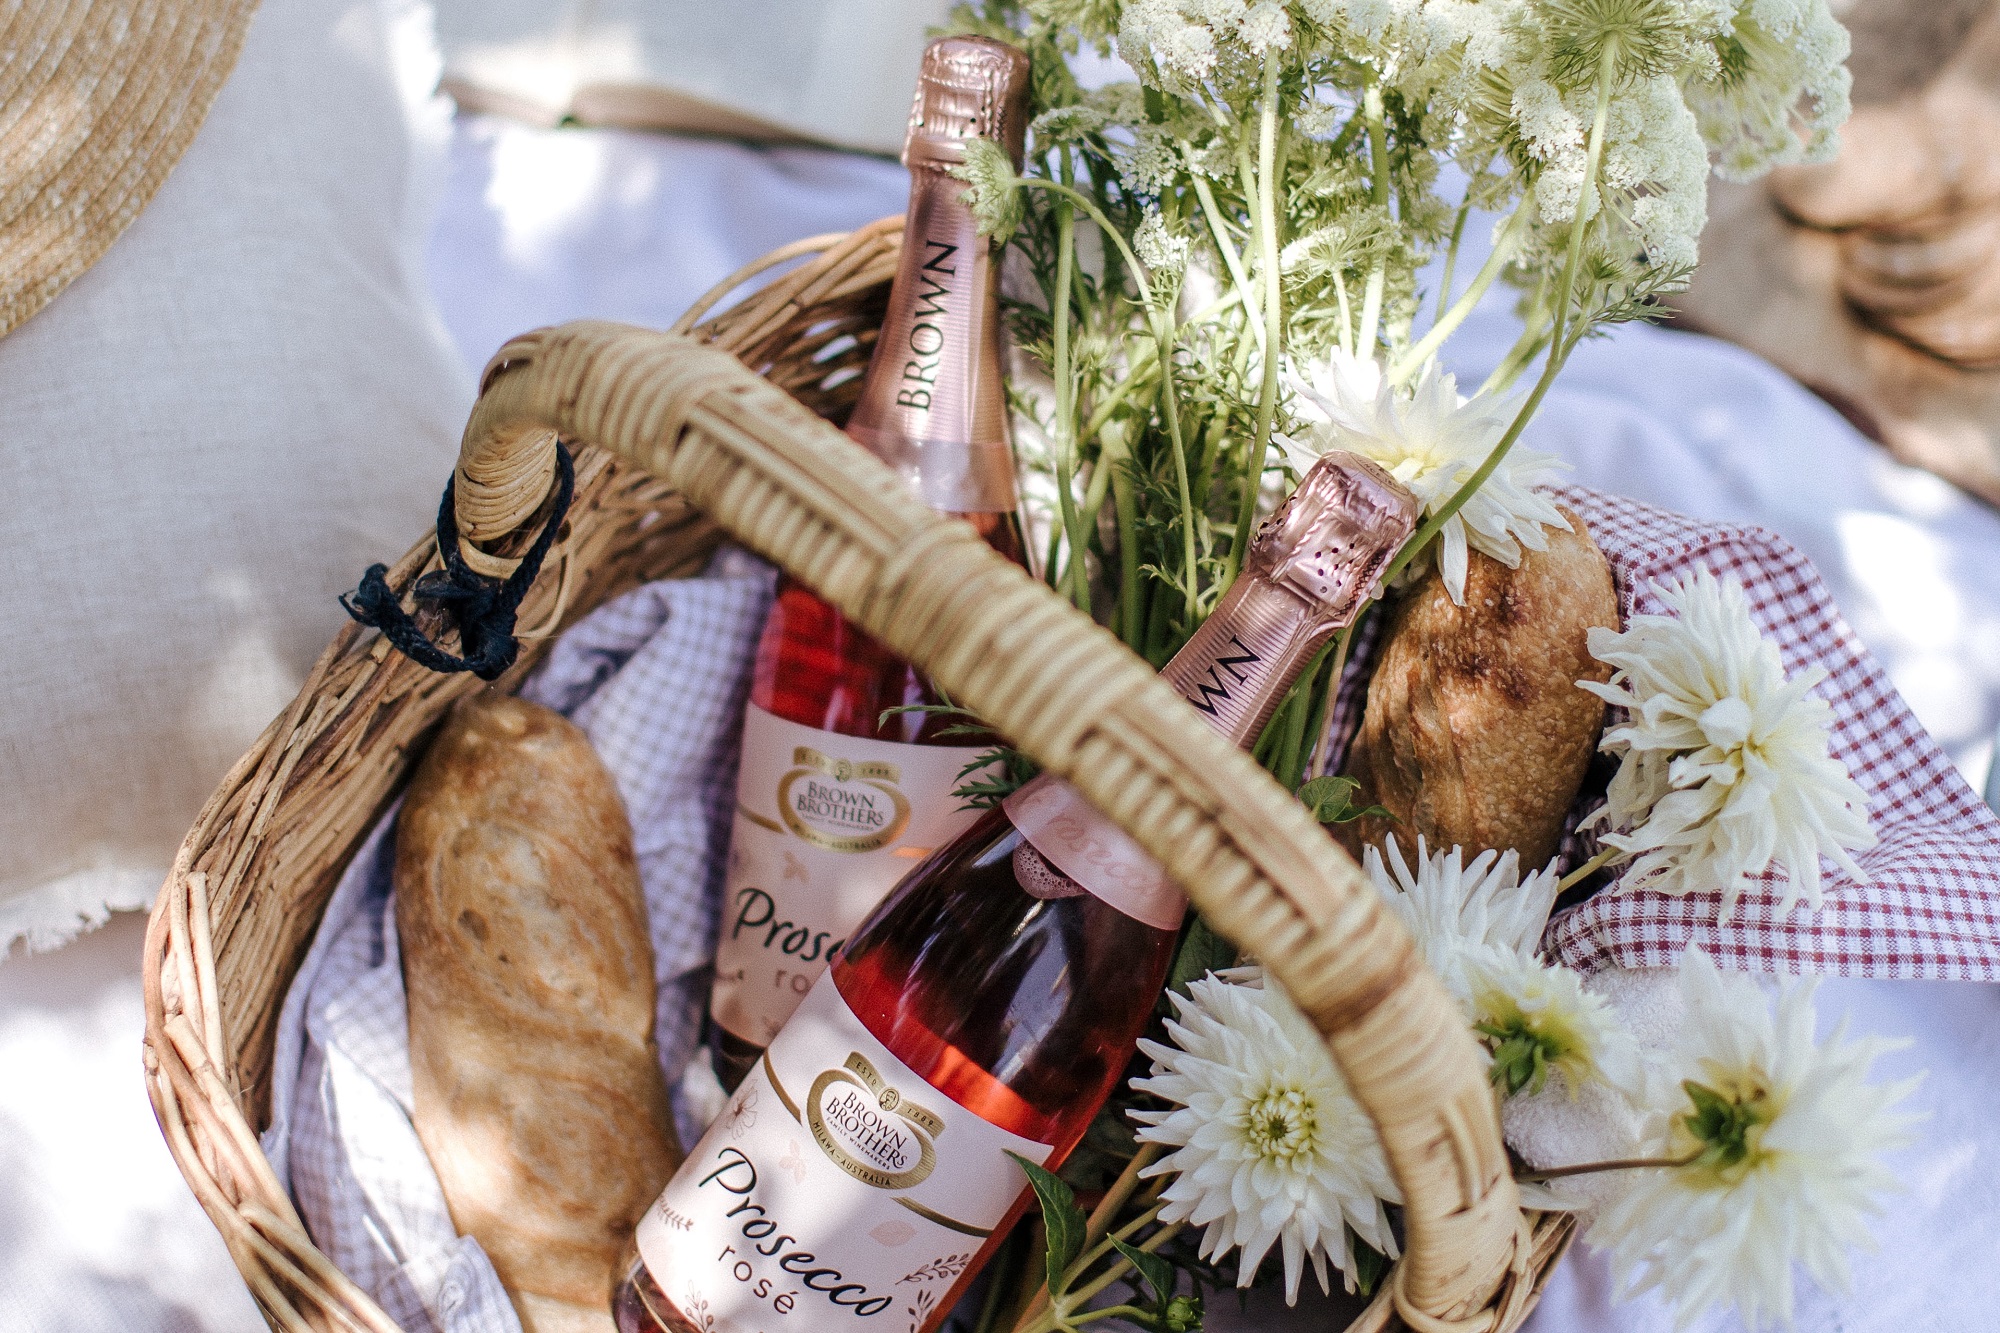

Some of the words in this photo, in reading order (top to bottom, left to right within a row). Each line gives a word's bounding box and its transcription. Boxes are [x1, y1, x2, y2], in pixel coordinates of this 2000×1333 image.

[896, 239, 960, 412] BROWN
[1187, 633, 1262, 717] WN
[797, 794, 884, 827] BROTHERS
[807, 780, 875, 809] BROWN
[732, 887, 846, 963] Pros
[774, 969, 811, 994] ro
[826, 1096, 908, 1169] BROTHERS
[826, 1116, 848, 1137] FAMILY
[849, 1137, 891, 1170] WINEMAKERS
[842, 1090, 908, 1150] BROWN
[907, 1107, 934, 1127] 1889
[698, 1146, 893, 1317] Prosecco
[717, 1243, 798, 1315] rosé
